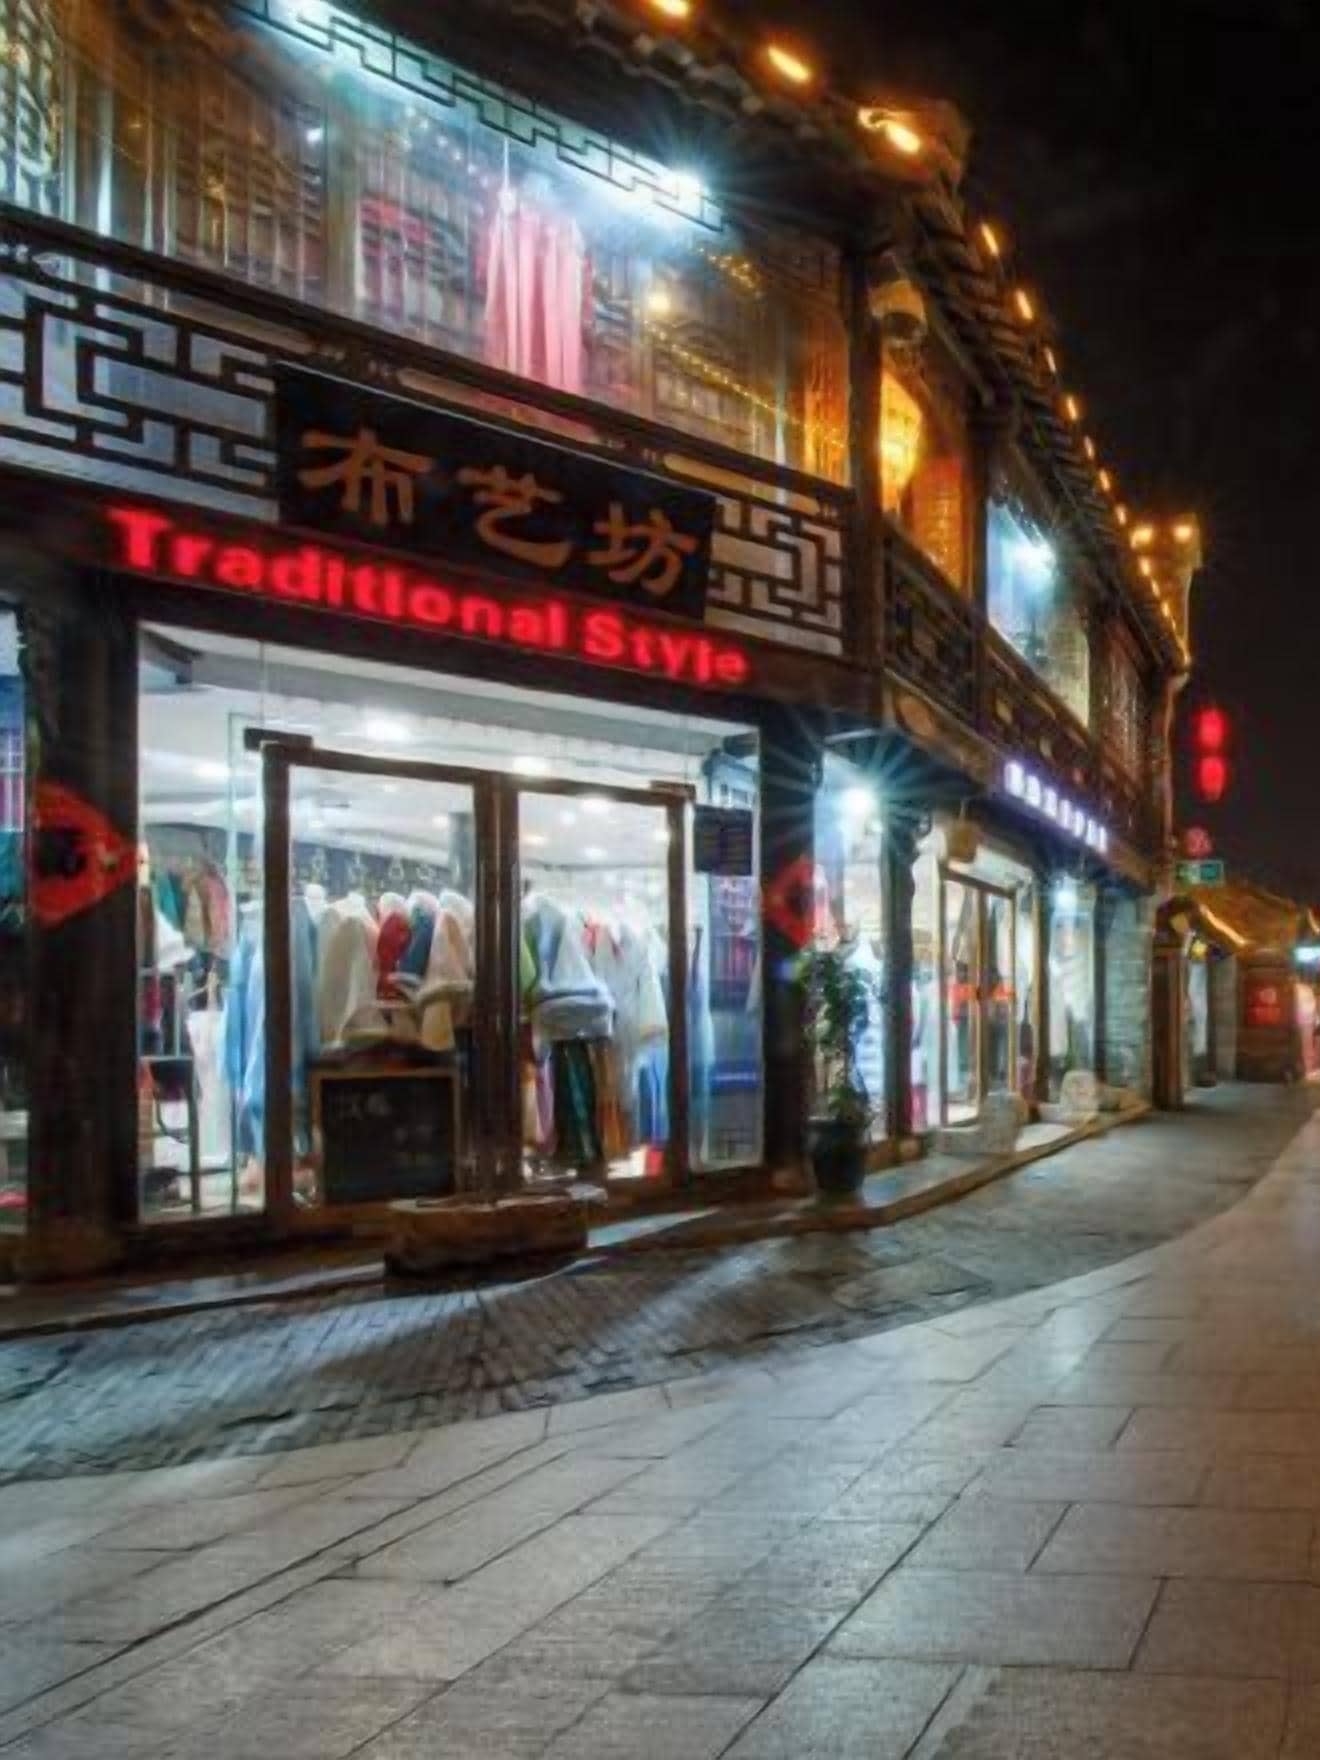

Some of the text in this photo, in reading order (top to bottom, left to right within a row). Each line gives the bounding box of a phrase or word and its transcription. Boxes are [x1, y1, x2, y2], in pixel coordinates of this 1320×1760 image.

[109, 507, 747, 684] Traditional Style
[298, 428, 698, 594] 布艺坊
